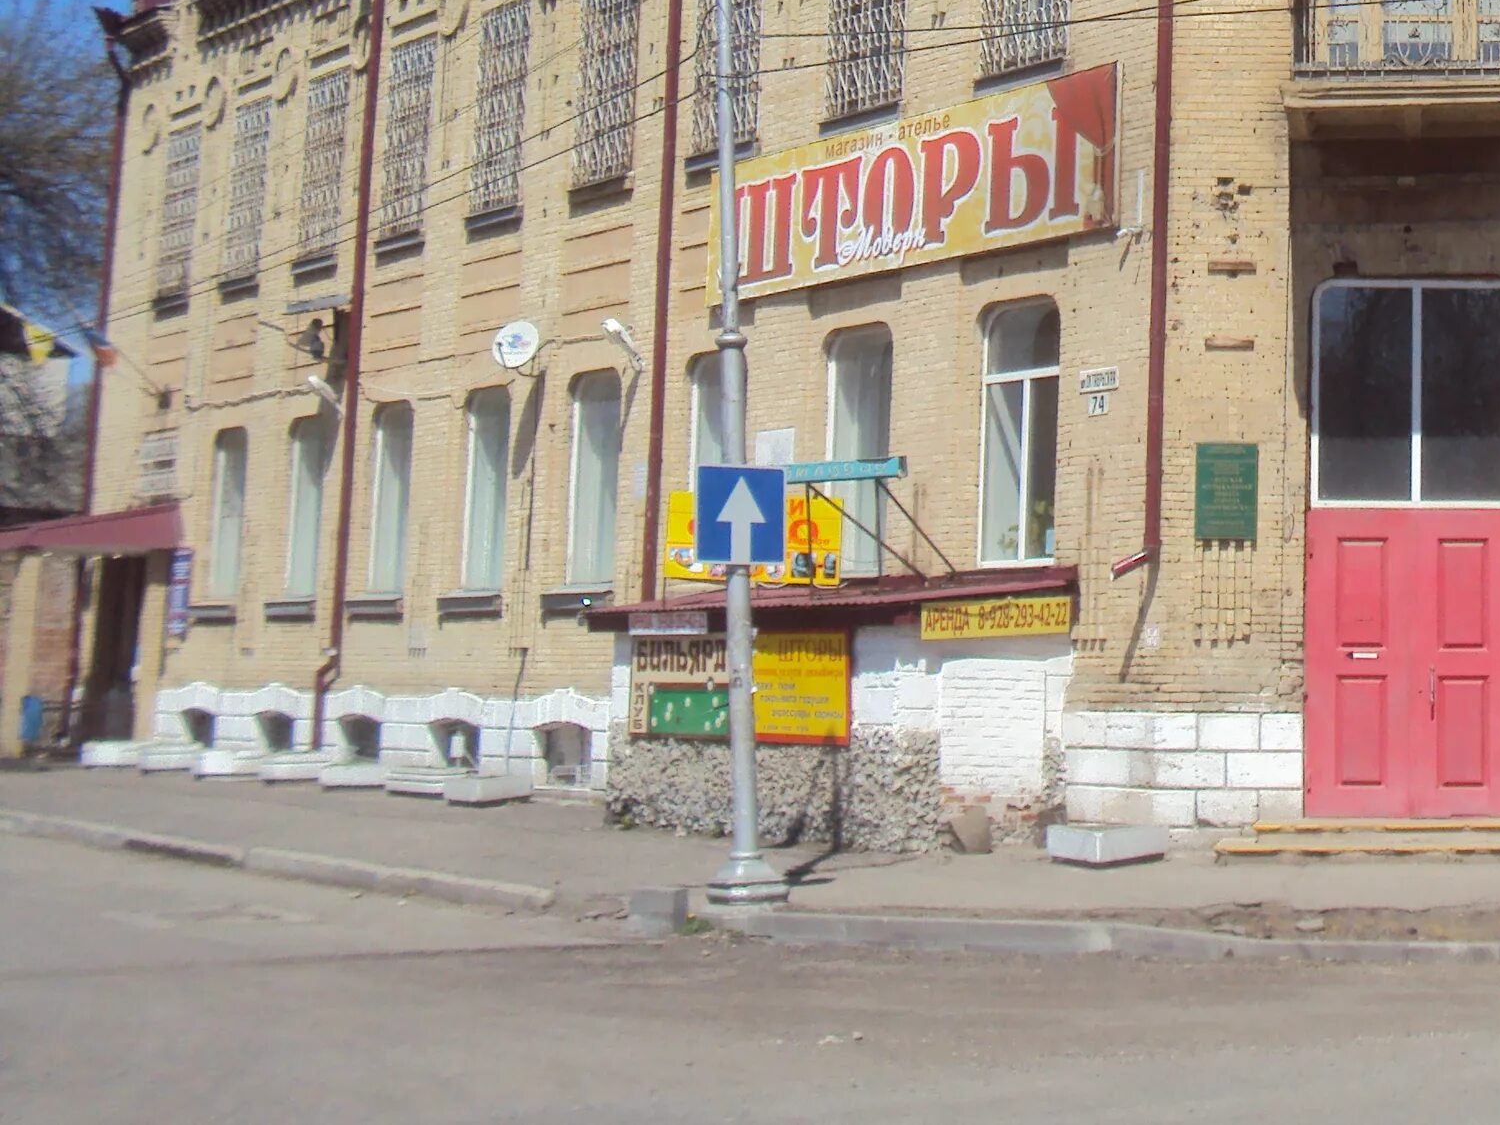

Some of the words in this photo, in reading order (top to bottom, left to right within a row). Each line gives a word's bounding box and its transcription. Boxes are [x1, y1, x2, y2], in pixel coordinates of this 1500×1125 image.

[825, 133, 883, 158] магазин
[898, 113, 951, 140] ателье
[735, 105, 1080, 283] ШТОРЫ
[839, 225, 926, 266] Модерн
[1092, 395, 1105, 414] 74
[925, 606, 969, 636] АРЕНДА
[977, 601, 1068, 630] 8-928-293-42-22
[637, 639, 727, 675] БИЛЬЯРД
[778, 638, 843, 662] ШТОРЫ
[632, 682, 646, 730] КЛУБ
